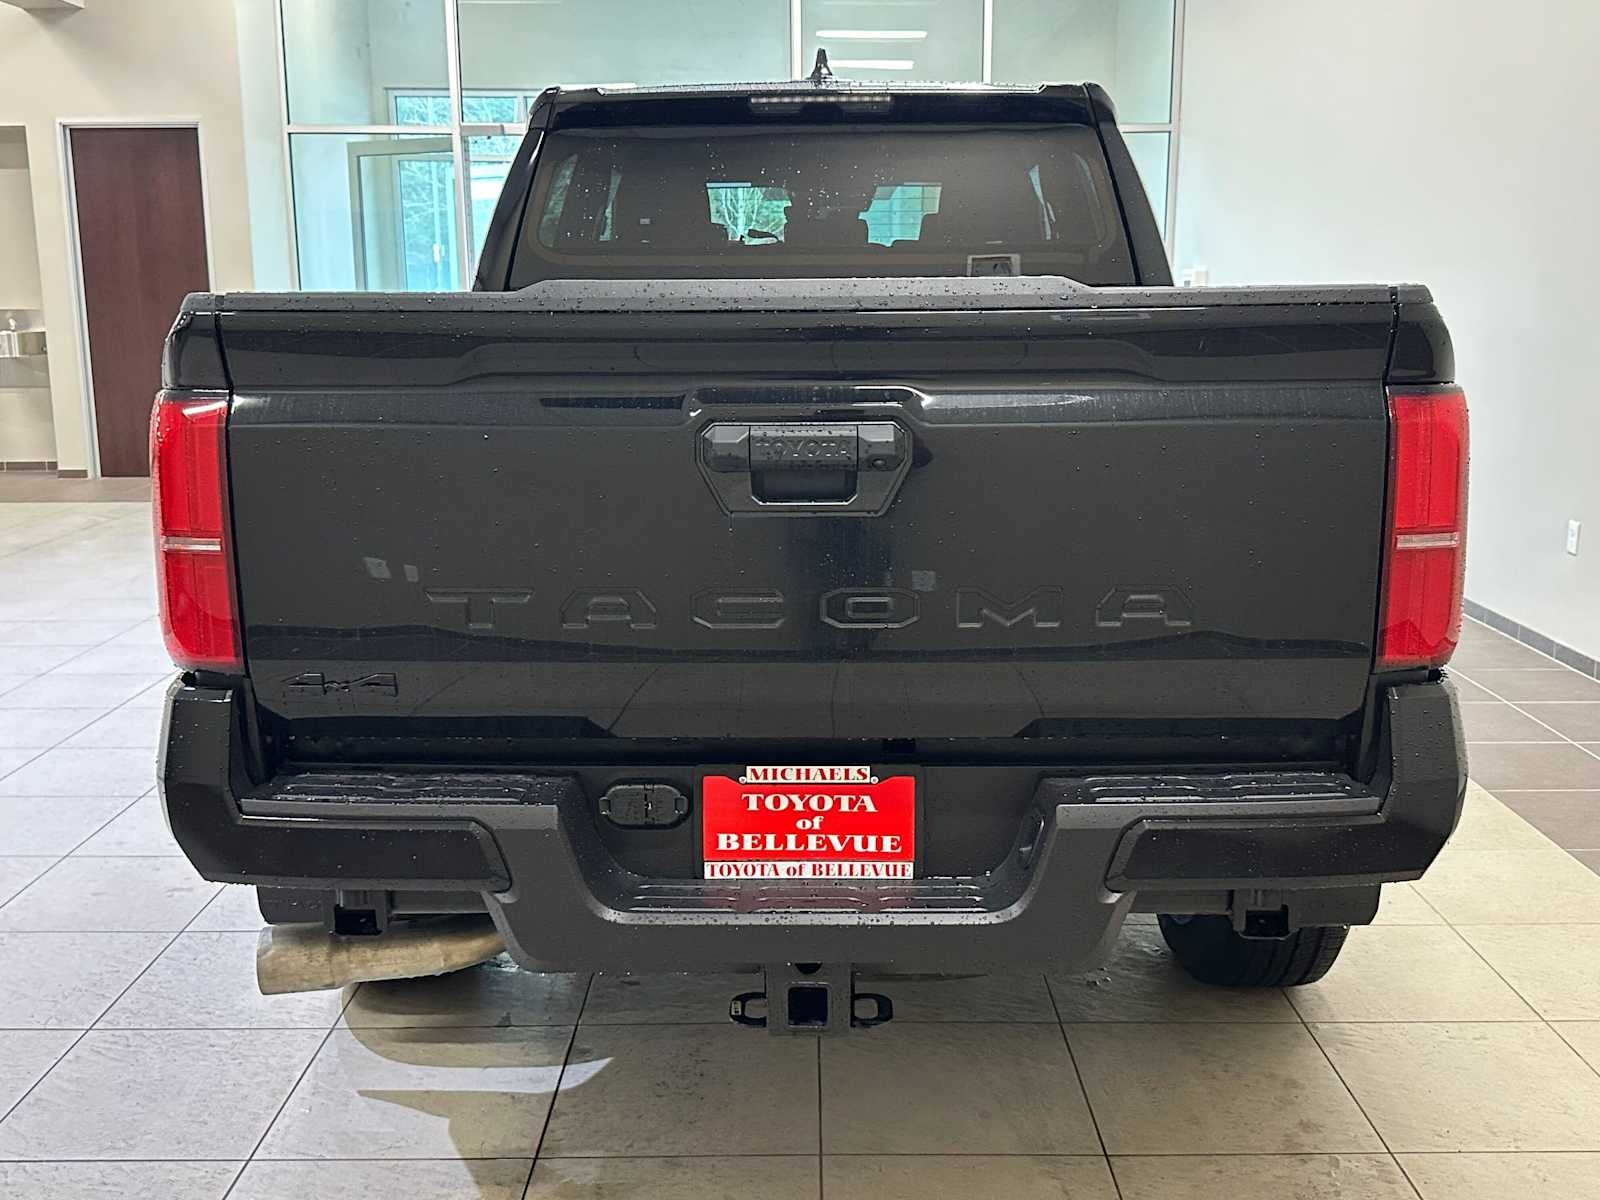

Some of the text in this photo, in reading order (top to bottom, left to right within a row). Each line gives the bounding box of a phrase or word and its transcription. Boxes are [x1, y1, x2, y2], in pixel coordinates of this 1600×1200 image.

[753, 439, 851, 459] TOYOTA
[423, 585, 1194, 630] TACOMA
[749, 767, 869, 781] MICHAELS
[741, 793, 878, 813] TOYOTA
[795, 816, 825, 830] of
[716, 833, 902, 853] BELLEVUE
[706, 863, 913, 877] TOYOTA of BELLEVUE
